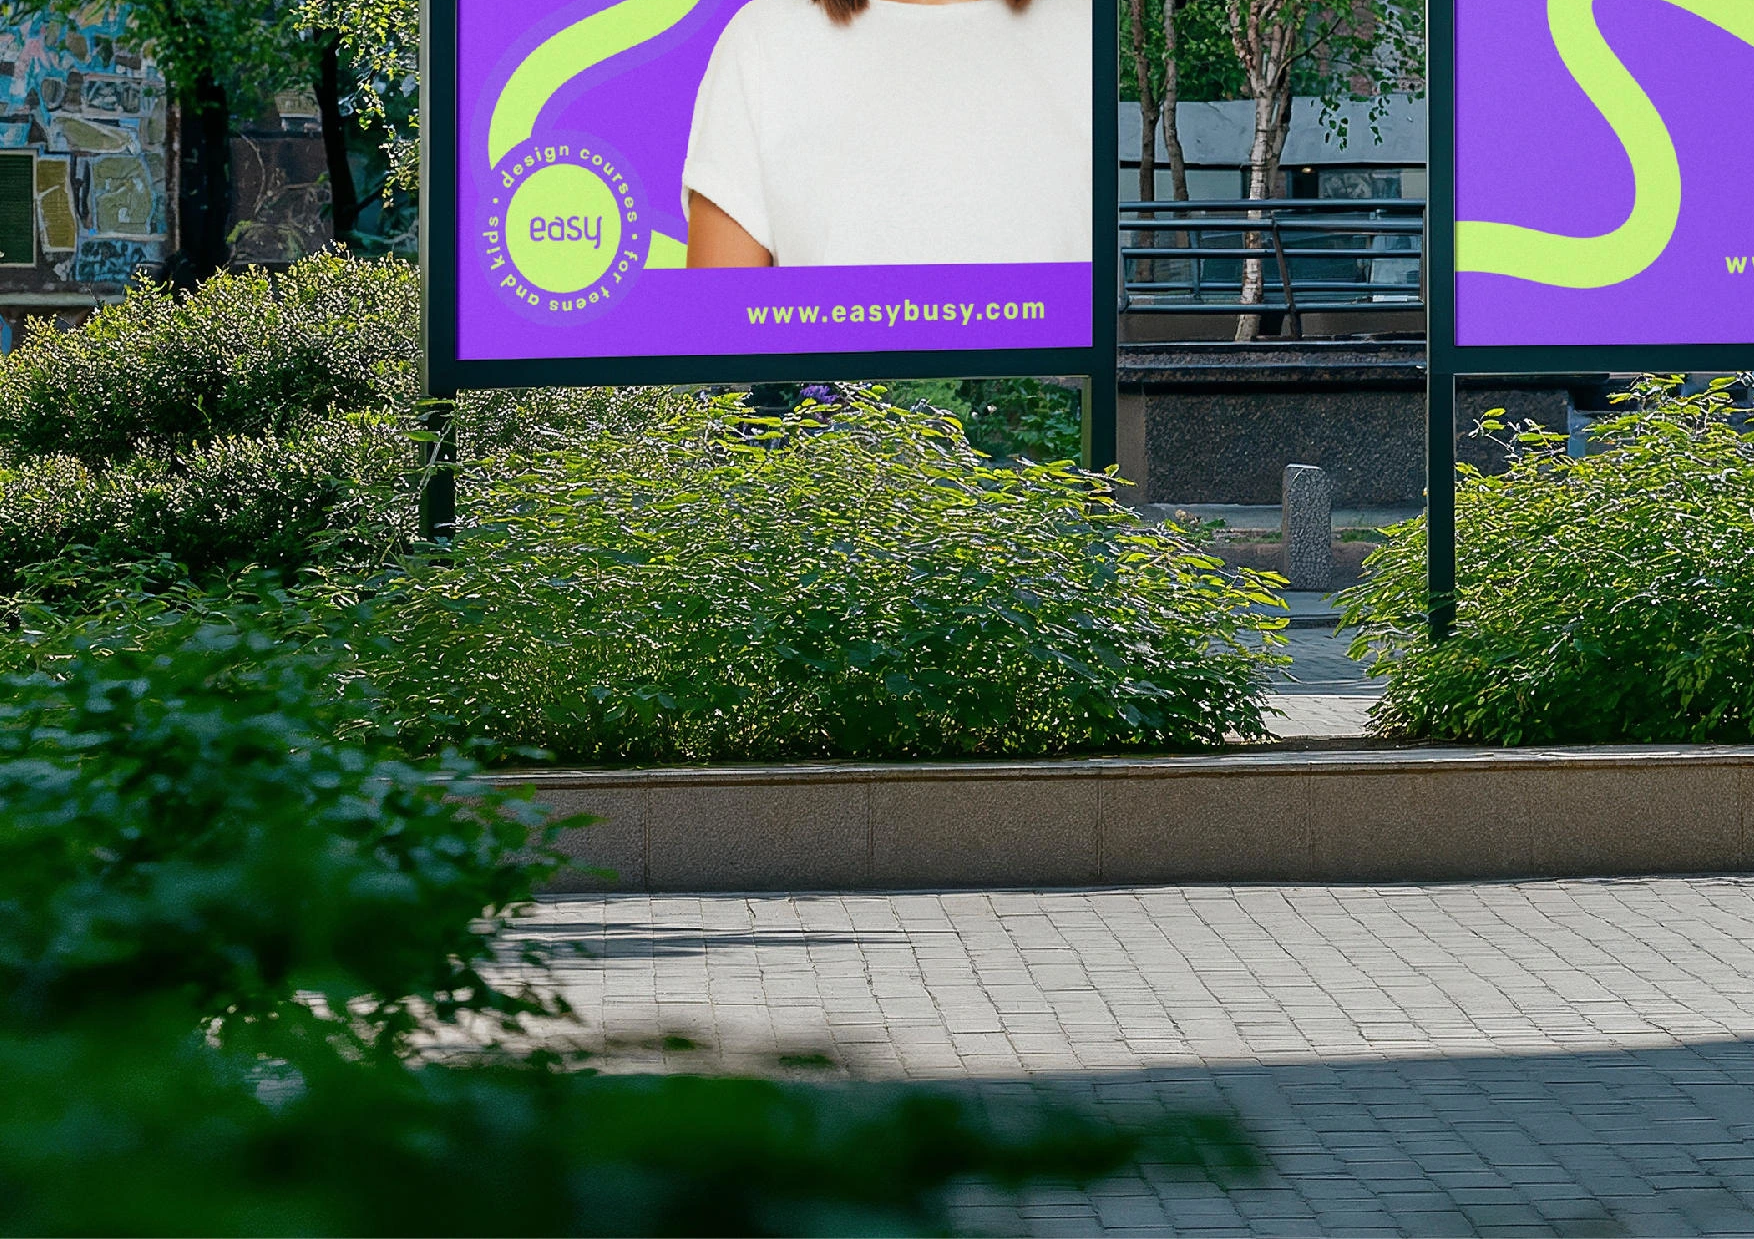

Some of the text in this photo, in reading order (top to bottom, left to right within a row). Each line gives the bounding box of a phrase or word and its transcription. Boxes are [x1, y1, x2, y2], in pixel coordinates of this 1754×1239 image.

[482, 145, 638, 311] design courses for teens and kids
[529, 215, 602, 249] easy
[747, 299, 1044, 325] www.easybusy.com
